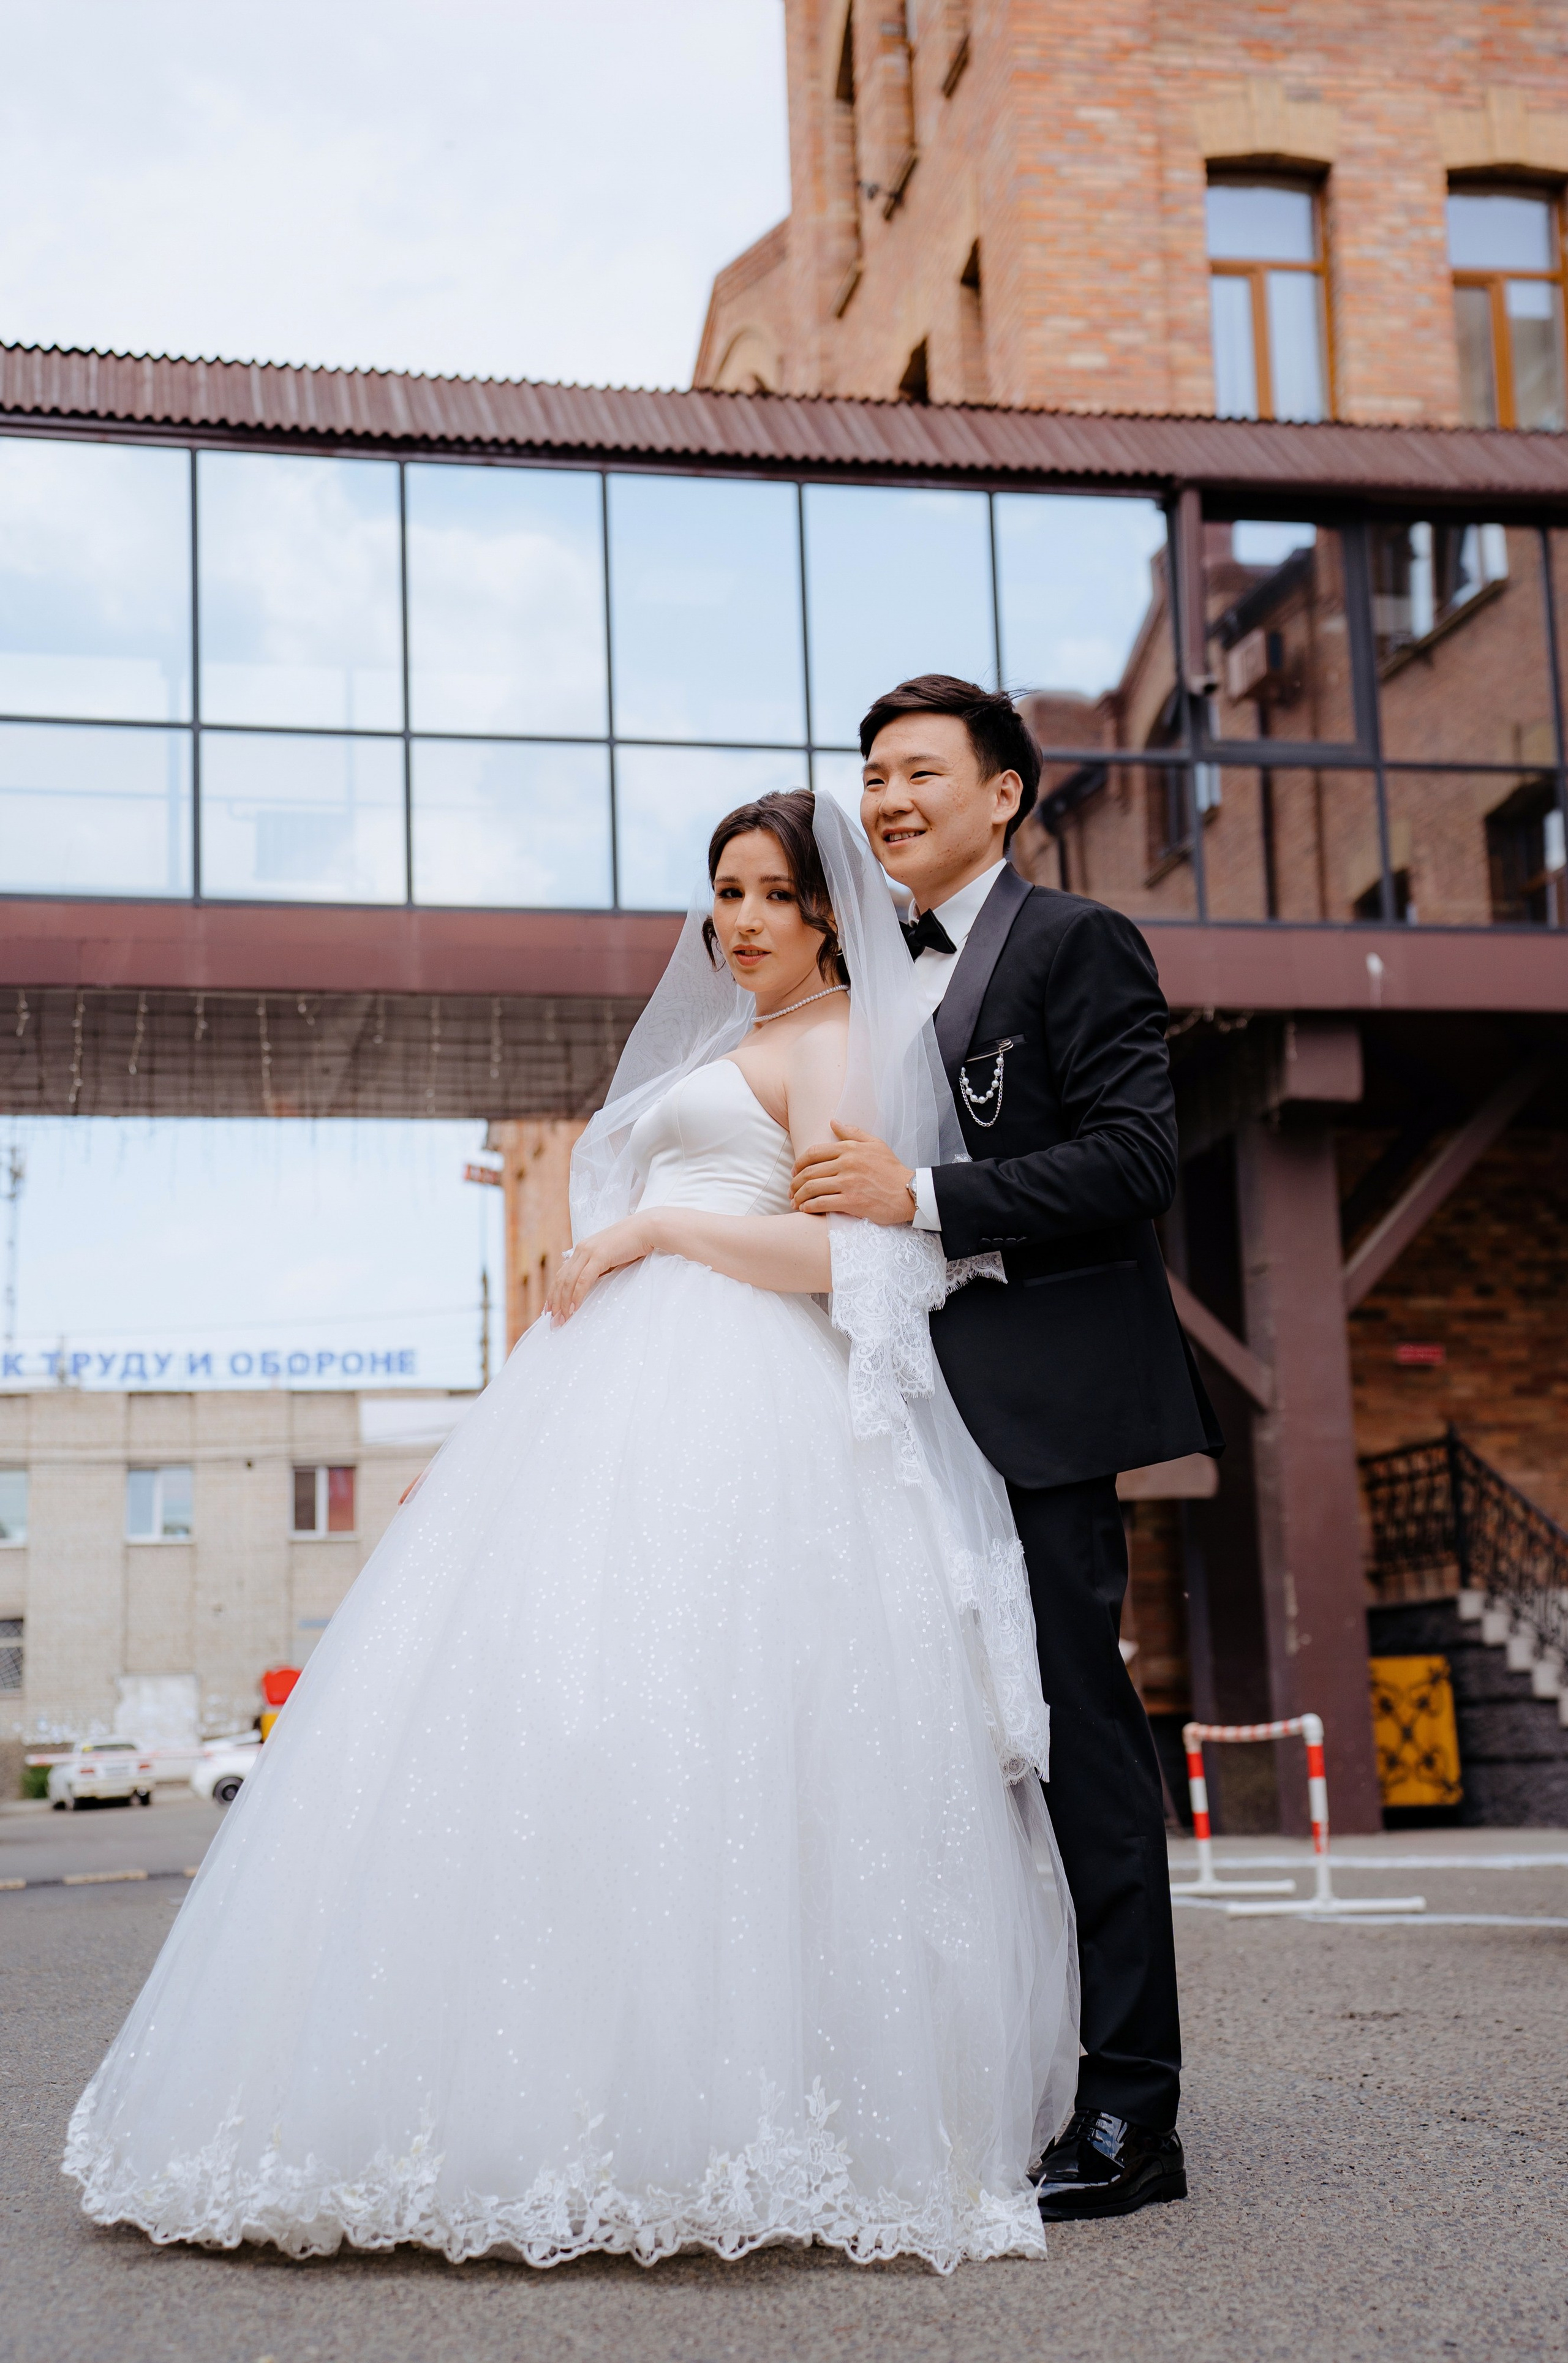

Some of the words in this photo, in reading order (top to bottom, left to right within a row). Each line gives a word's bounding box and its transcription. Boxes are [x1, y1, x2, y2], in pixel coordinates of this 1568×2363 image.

[3, 1351, 23, 1377] К
[42, 1349, 172, 1381] ТРУДУ
[188, 1351, 211, 1376] И
[230, 1350, 417, 1376] ОБОРОНЕ
